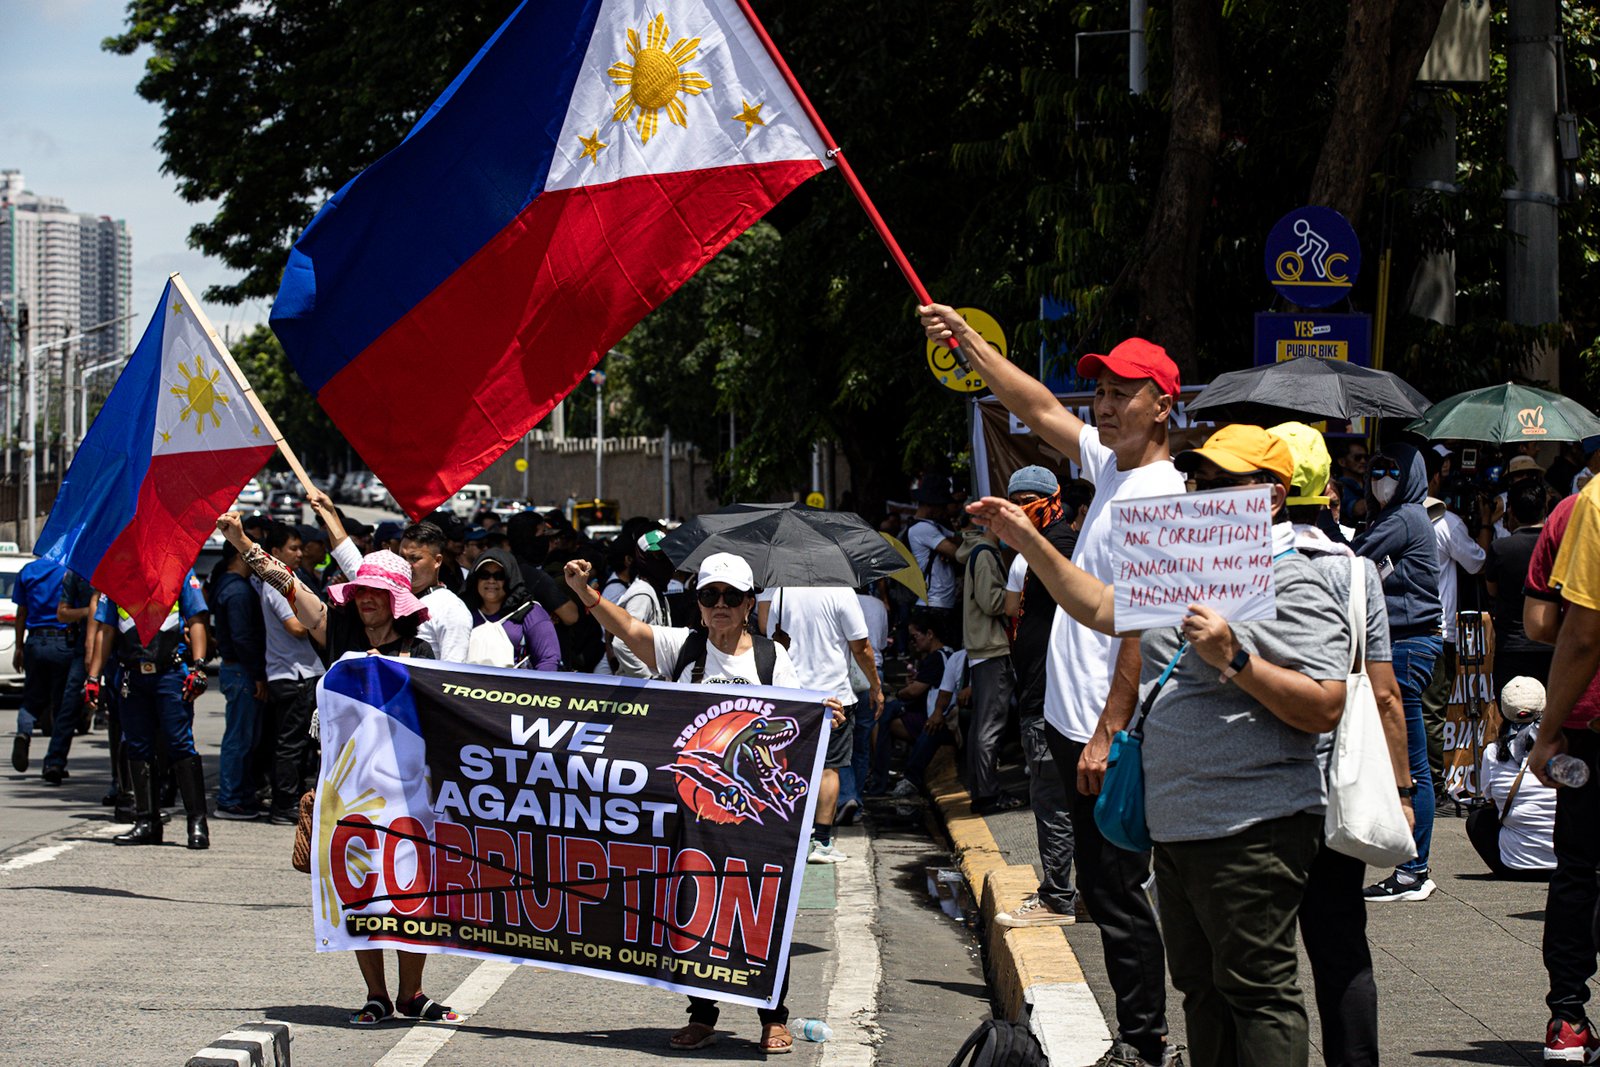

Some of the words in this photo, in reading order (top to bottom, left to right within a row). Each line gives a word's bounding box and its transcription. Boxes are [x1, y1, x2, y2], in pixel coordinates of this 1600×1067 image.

[1294, 321, 1314, 337] YES
[1286, 344, 1317, 358] PUBLIC
[1319, 344, 1338, 357] BIKE
[1119, 501, 1183, 527] NAKAKA
[1191, 499, 1237, 519] SUKA
[1245, 497, 1266, 513] NA
[1123, 531, 1150, 547] ANG
[1157, 521, 1268, 548] CORRUPTION!
[1120, 556, 1204, 580] PANAGUTIN
[1212, 557, 1243, 571] ANG
[1248, 554, 1272, 568] MGA
[441, 683, 561, 709] TROODONS
[567, 697, 650, 716] NATION
[510, 714, 613, 754] WE
[672, 698, 776, 749] TROODONS
[459, 744, 649, 795] STAND
[433, 780, 678, 838] AGAINST
[330, 814, 783, 967] CORRUPTION
[403, 920, 451, 937] OUR
[458, 925, 564, 955] CHILDREN,
[571, 941, 612, 961] FOR
[618, 948, 657, 968] OUR
